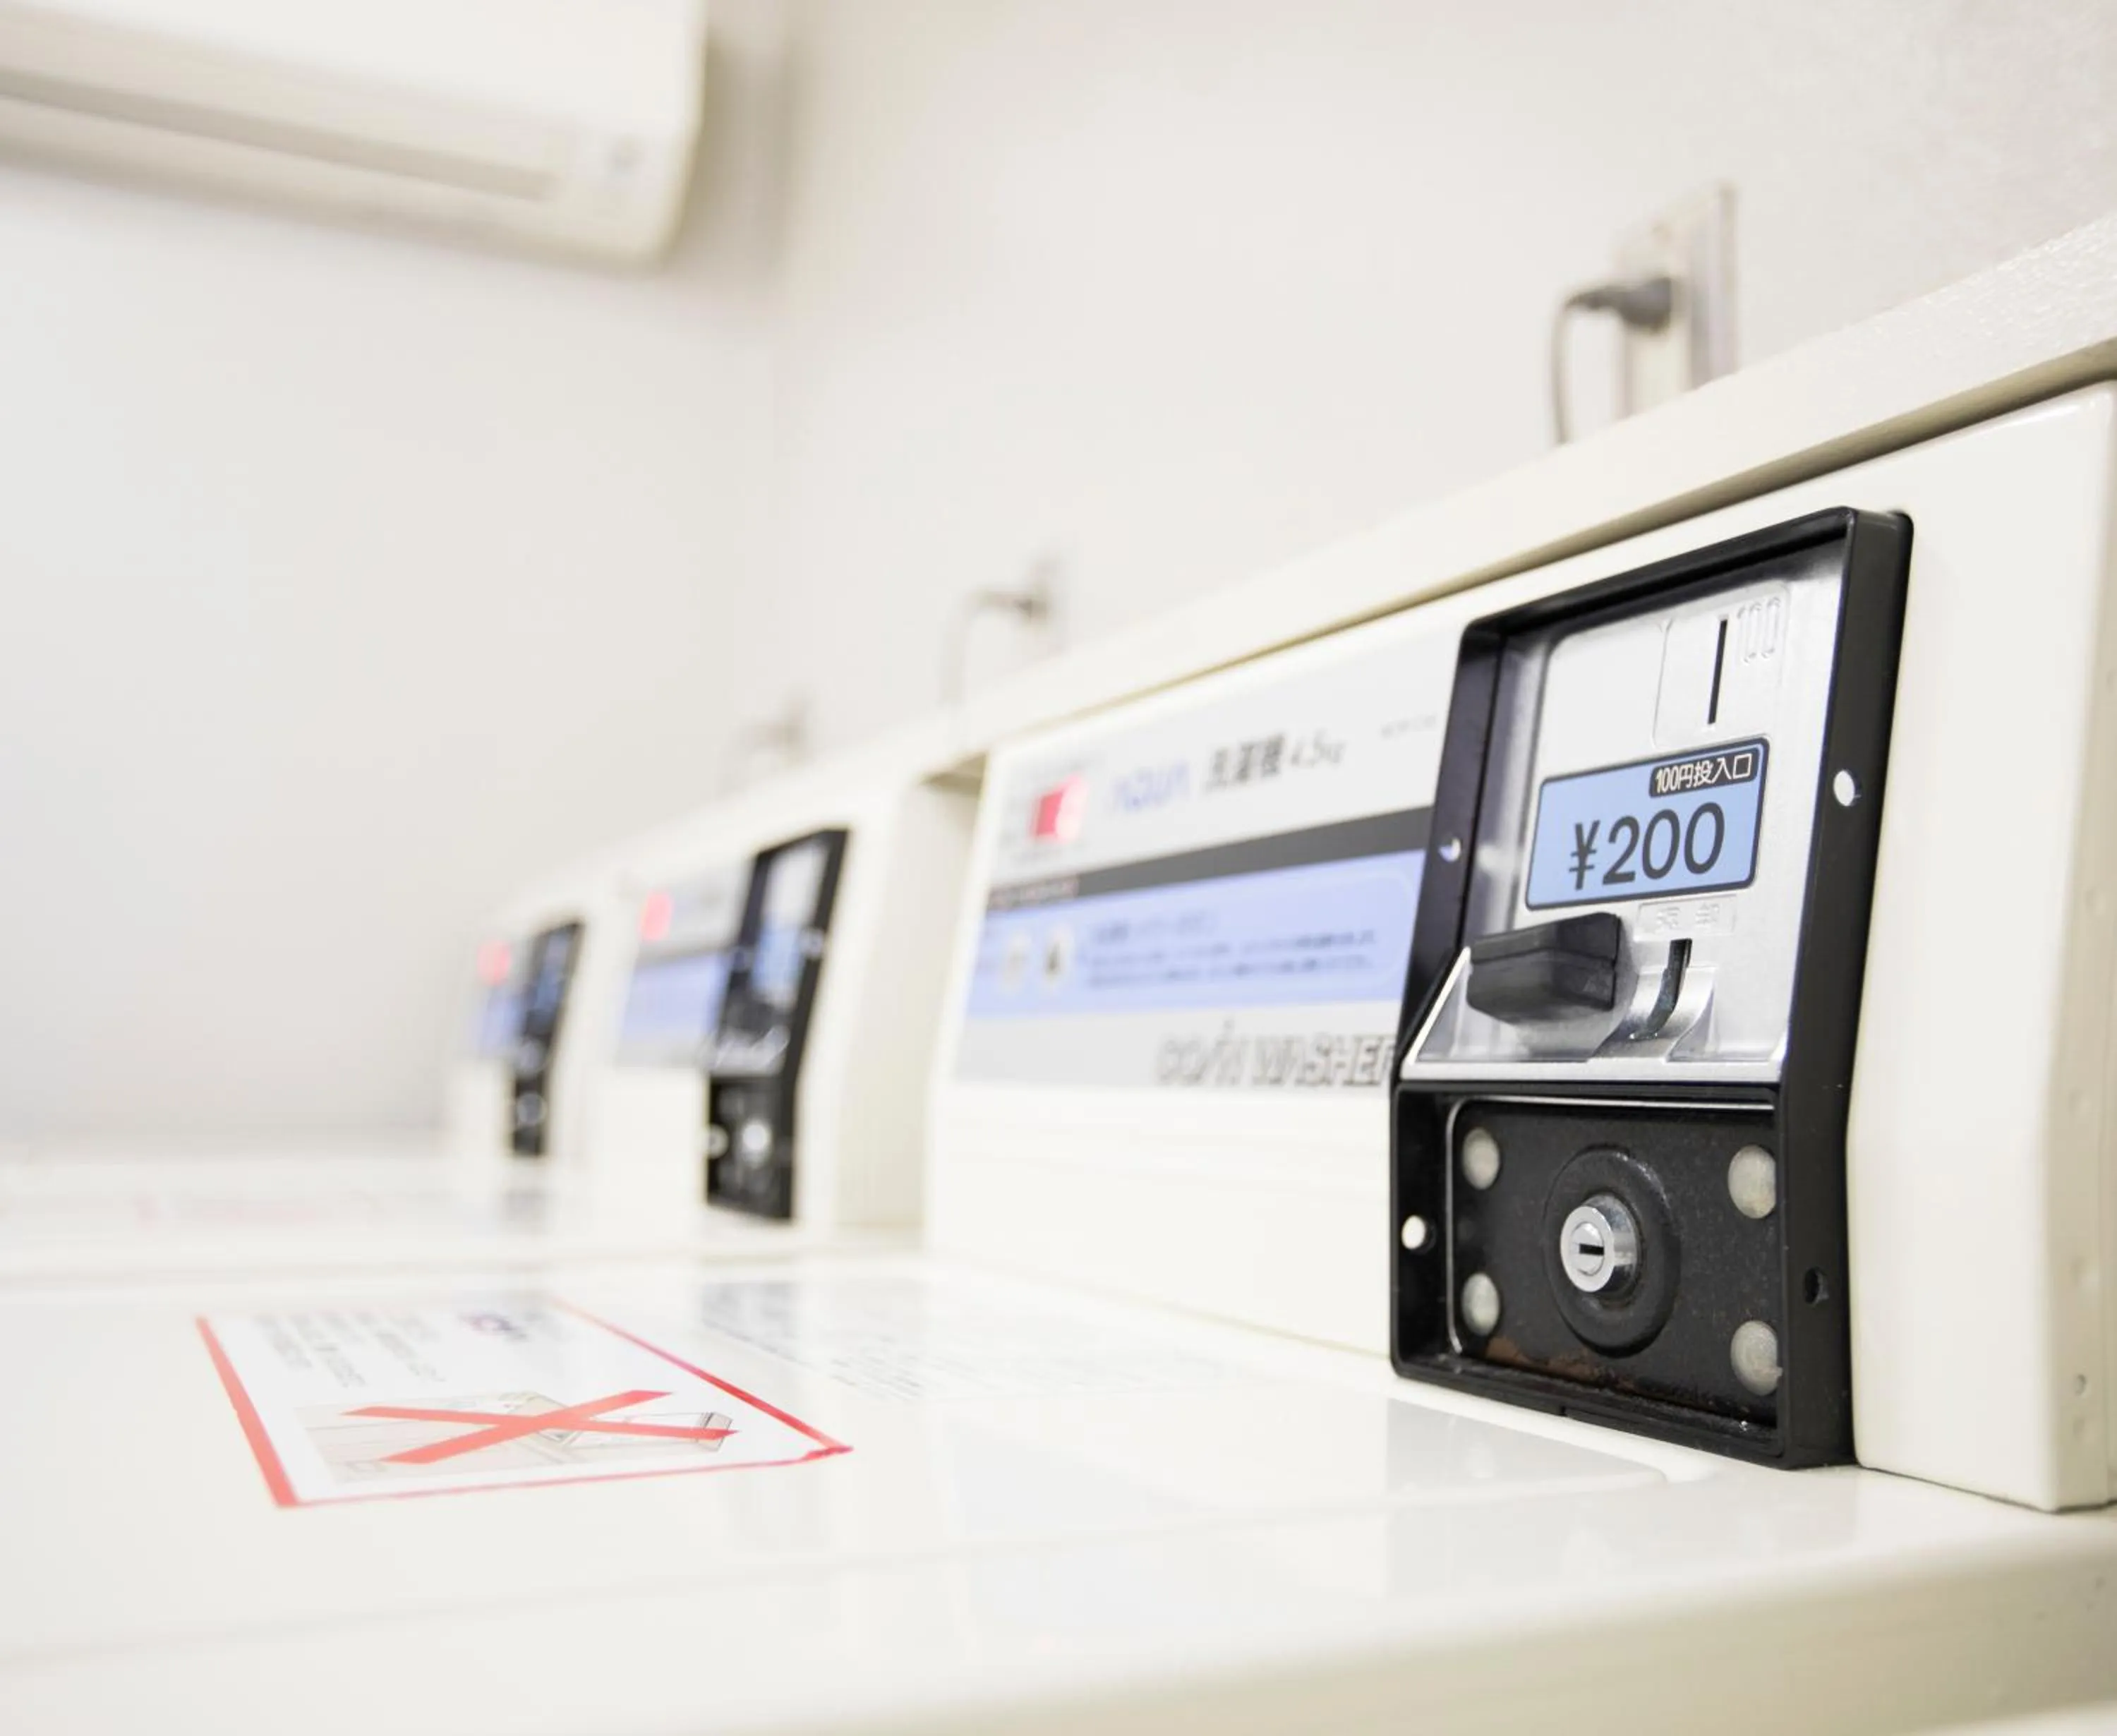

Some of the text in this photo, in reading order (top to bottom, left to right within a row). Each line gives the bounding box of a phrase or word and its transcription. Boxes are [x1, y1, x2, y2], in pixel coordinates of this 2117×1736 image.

[1655, 753, 1753, 794] 100円投入口
[1568, 802, 1725, 891] ¥200
